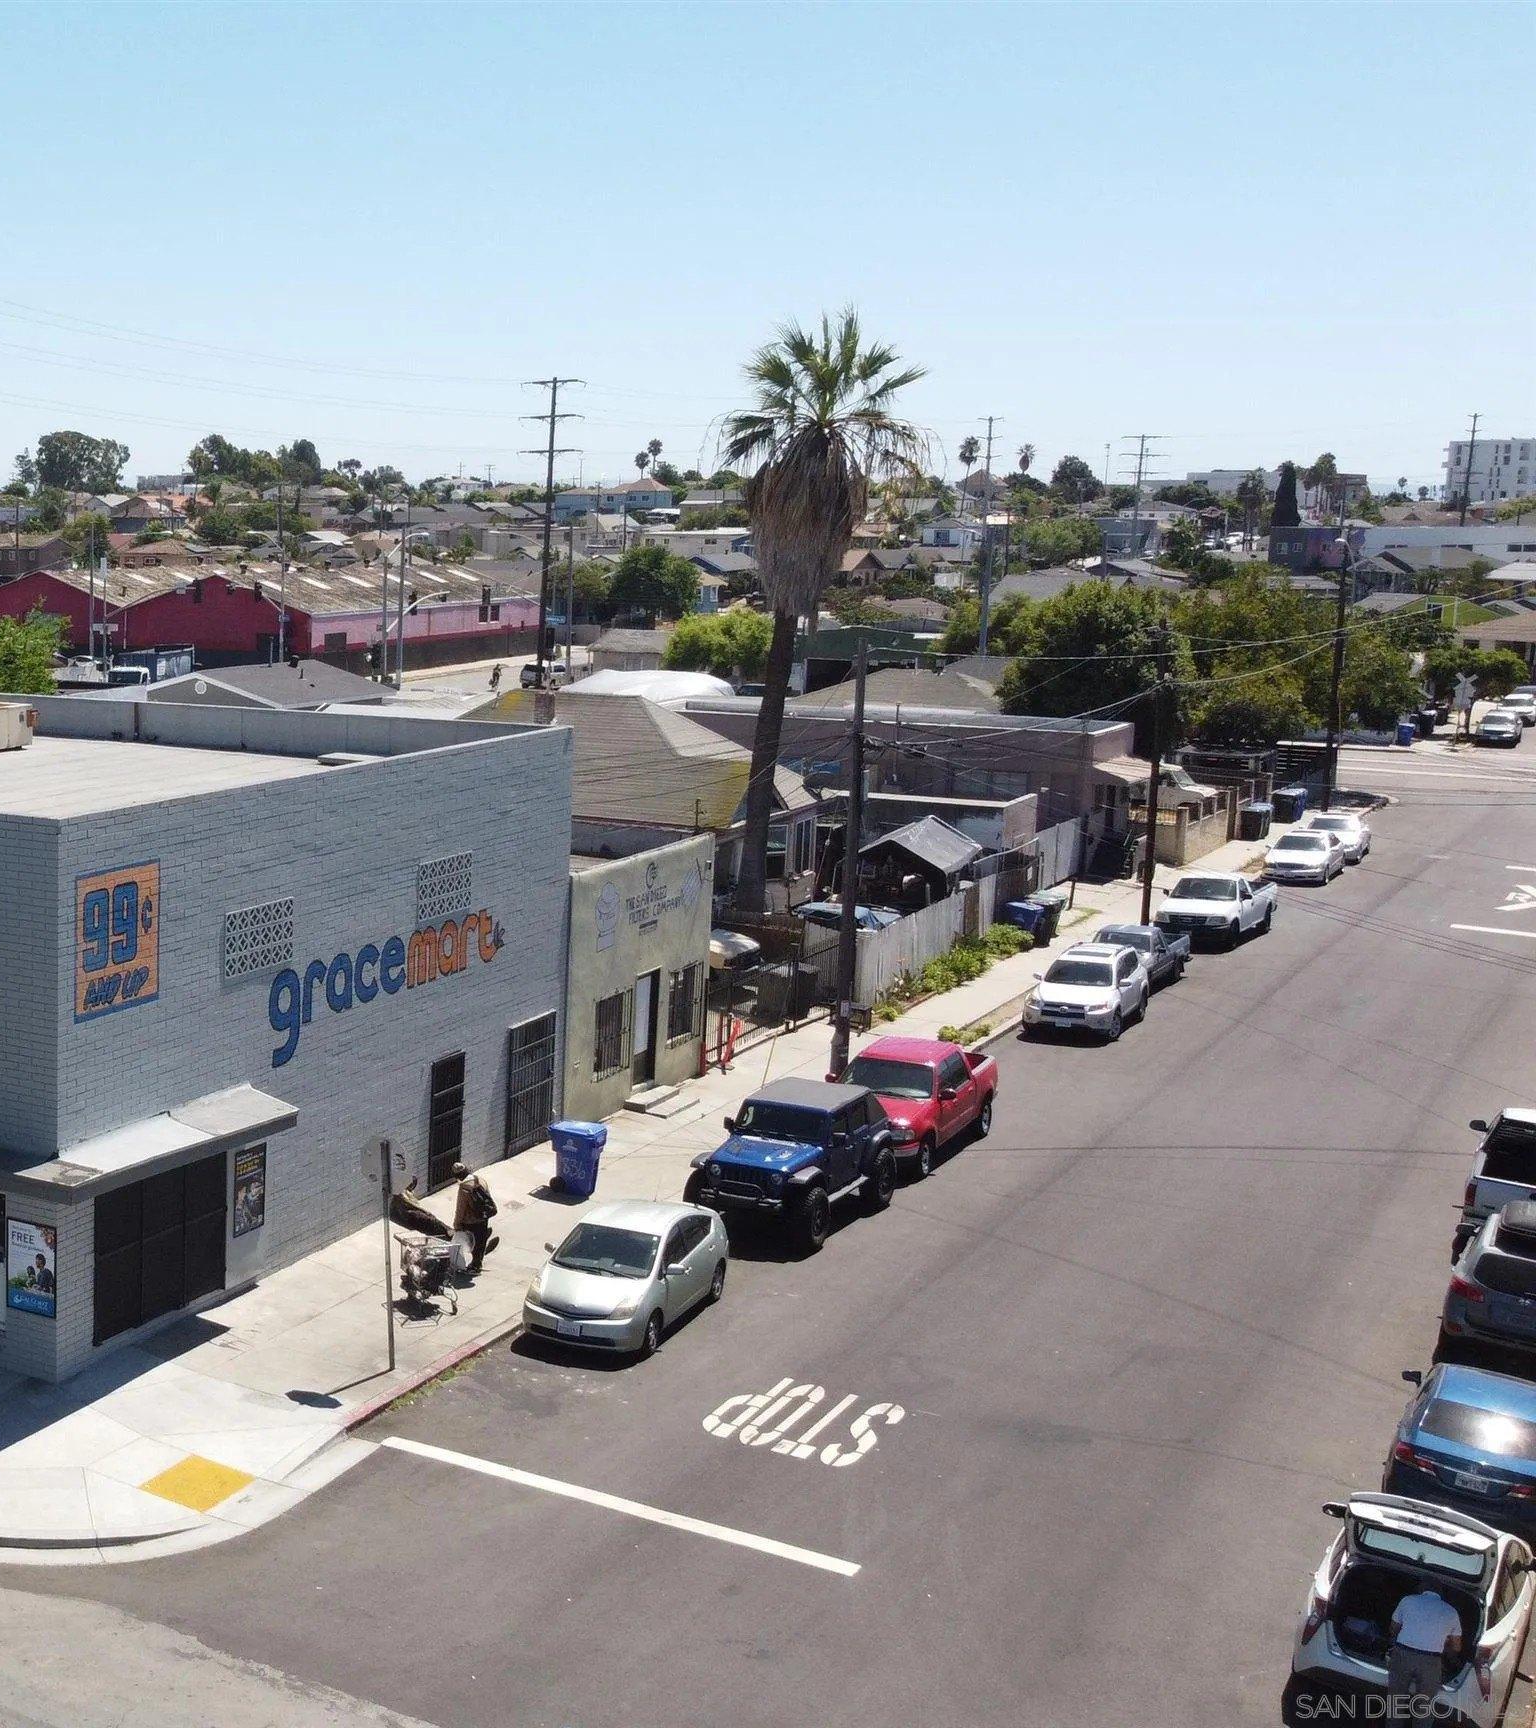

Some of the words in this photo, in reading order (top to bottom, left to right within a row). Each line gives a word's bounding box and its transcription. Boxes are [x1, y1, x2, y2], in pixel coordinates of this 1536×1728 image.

[84, 973, 121, 1011] AND
[121, 965, 150, 1000] UP
[269, 909, 499, 1069] gracemart
[11, 1230, 35, 1245] FREE
[702, 1377, 906, 1467] STOP
